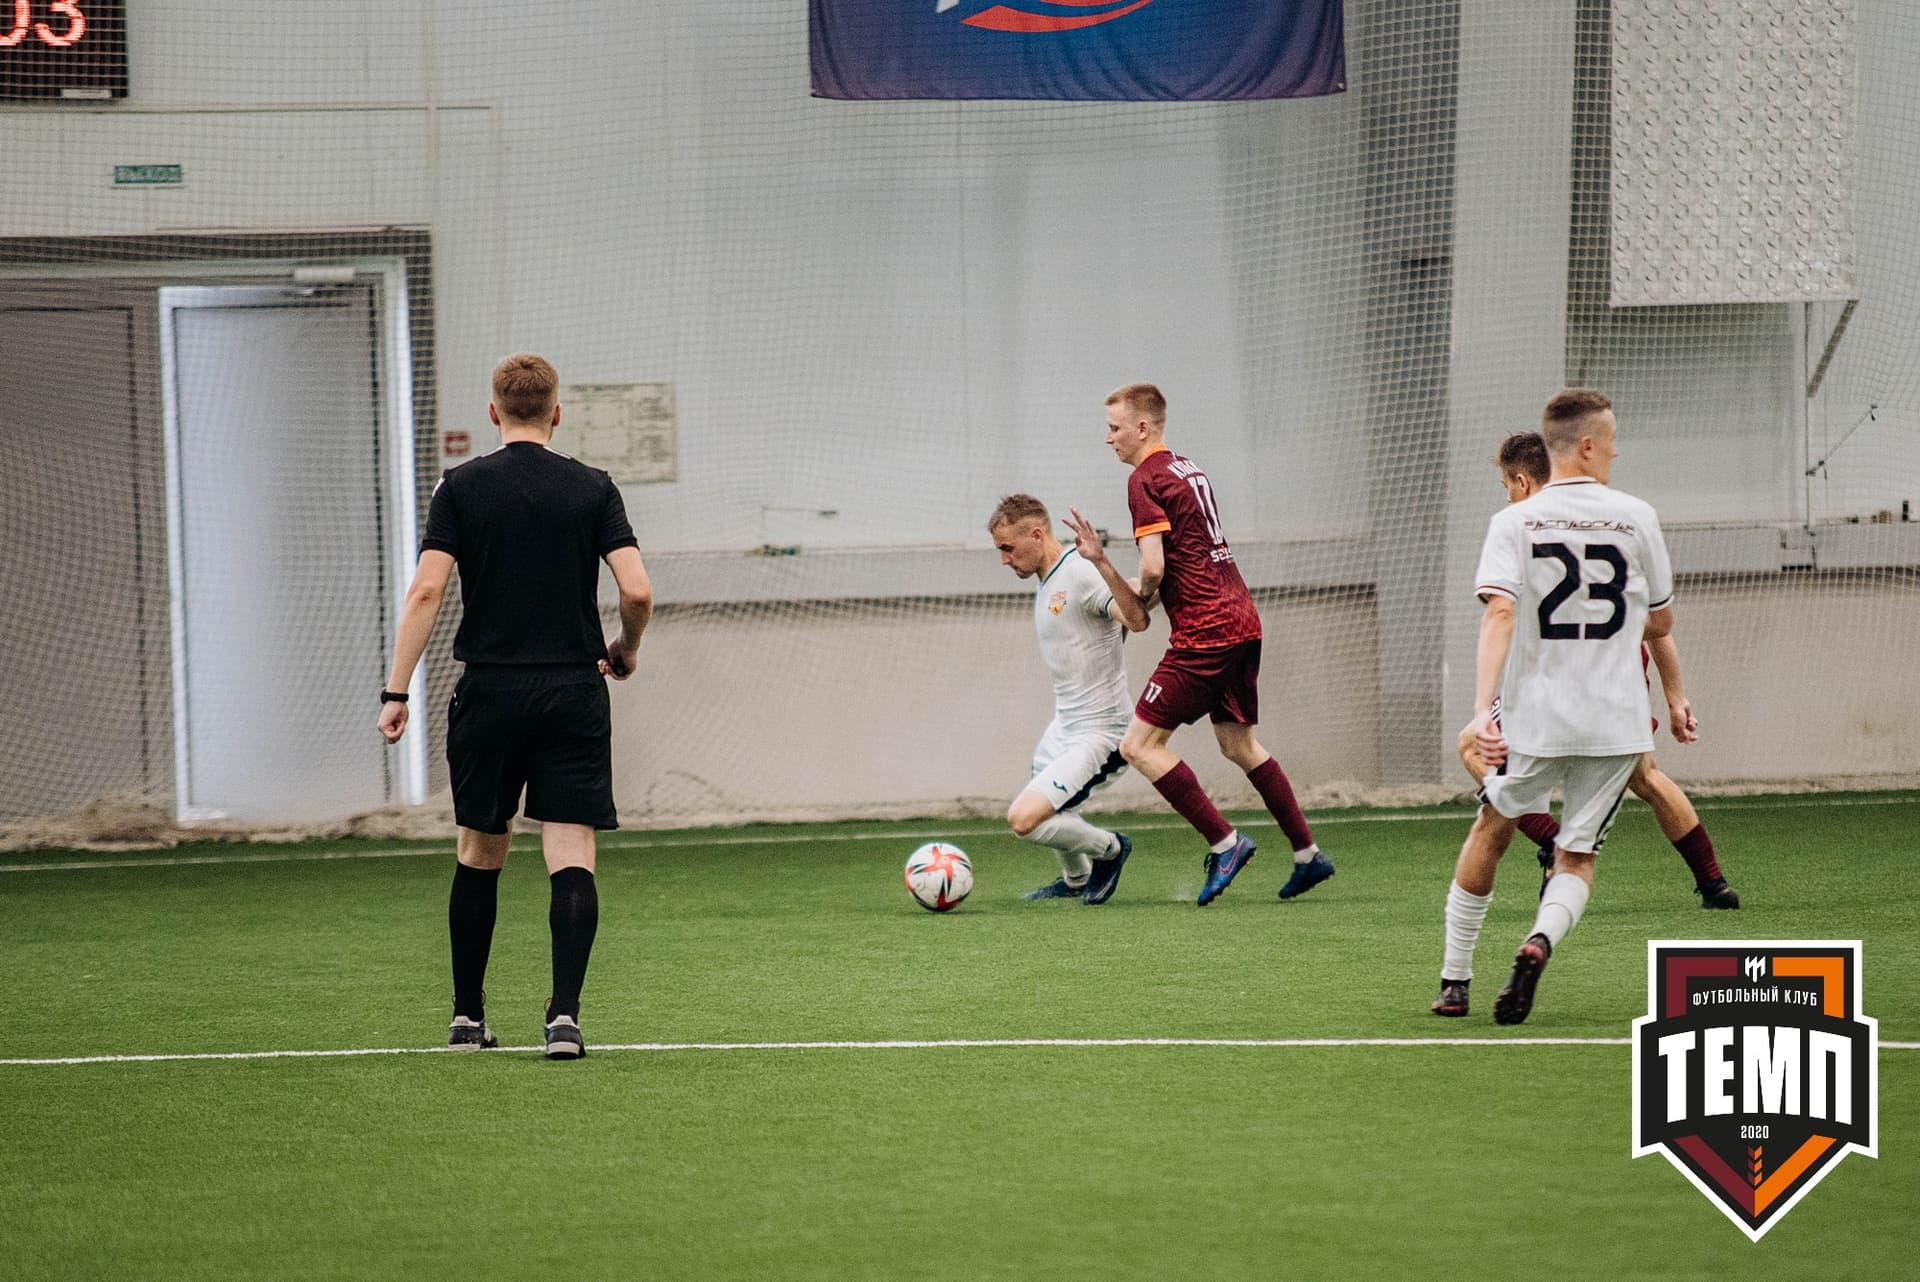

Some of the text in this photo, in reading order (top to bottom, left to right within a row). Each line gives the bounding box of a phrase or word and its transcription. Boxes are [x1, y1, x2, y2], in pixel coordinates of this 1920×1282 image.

[1187, 475, 1223, 545] 17
[1532, 543, 1627, 640] 23
[1145, 682, 1162, 703] 17
